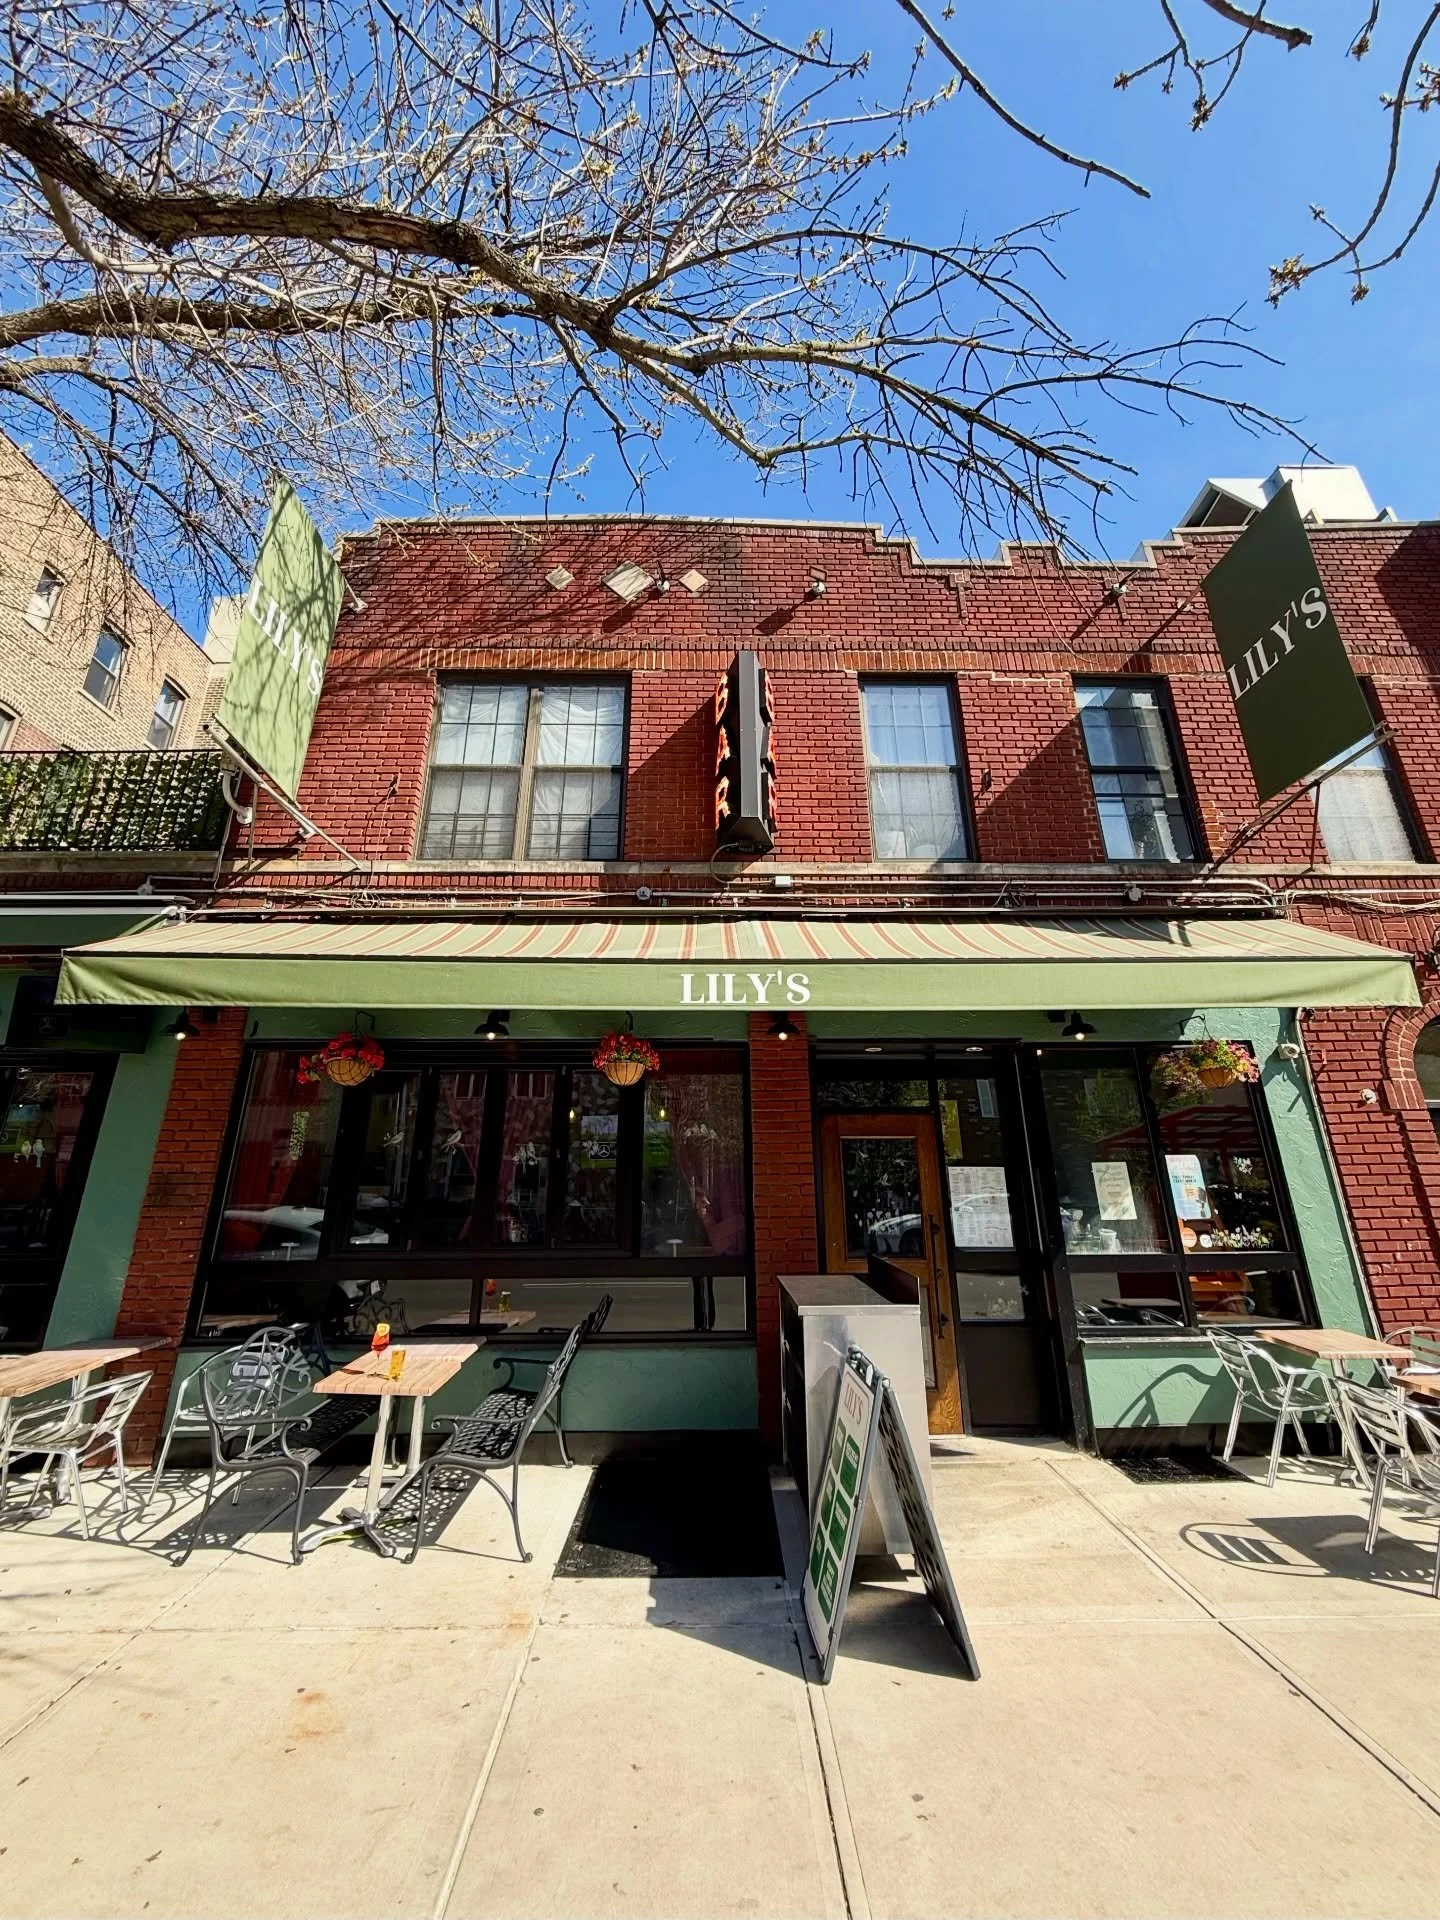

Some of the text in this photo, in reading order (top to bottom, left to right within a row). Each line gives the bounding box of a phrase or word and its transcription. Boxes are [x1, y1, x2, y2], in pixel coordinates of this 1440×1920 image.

[248, 580, 324, 696] LILY'S
[1227, 586, 1328, 700] LILY'S
[715, 671, 731, 831] BAR
[680, 970, 810, 1004] LILY'S
[844, 1383, 864, 1425] LILY'S
